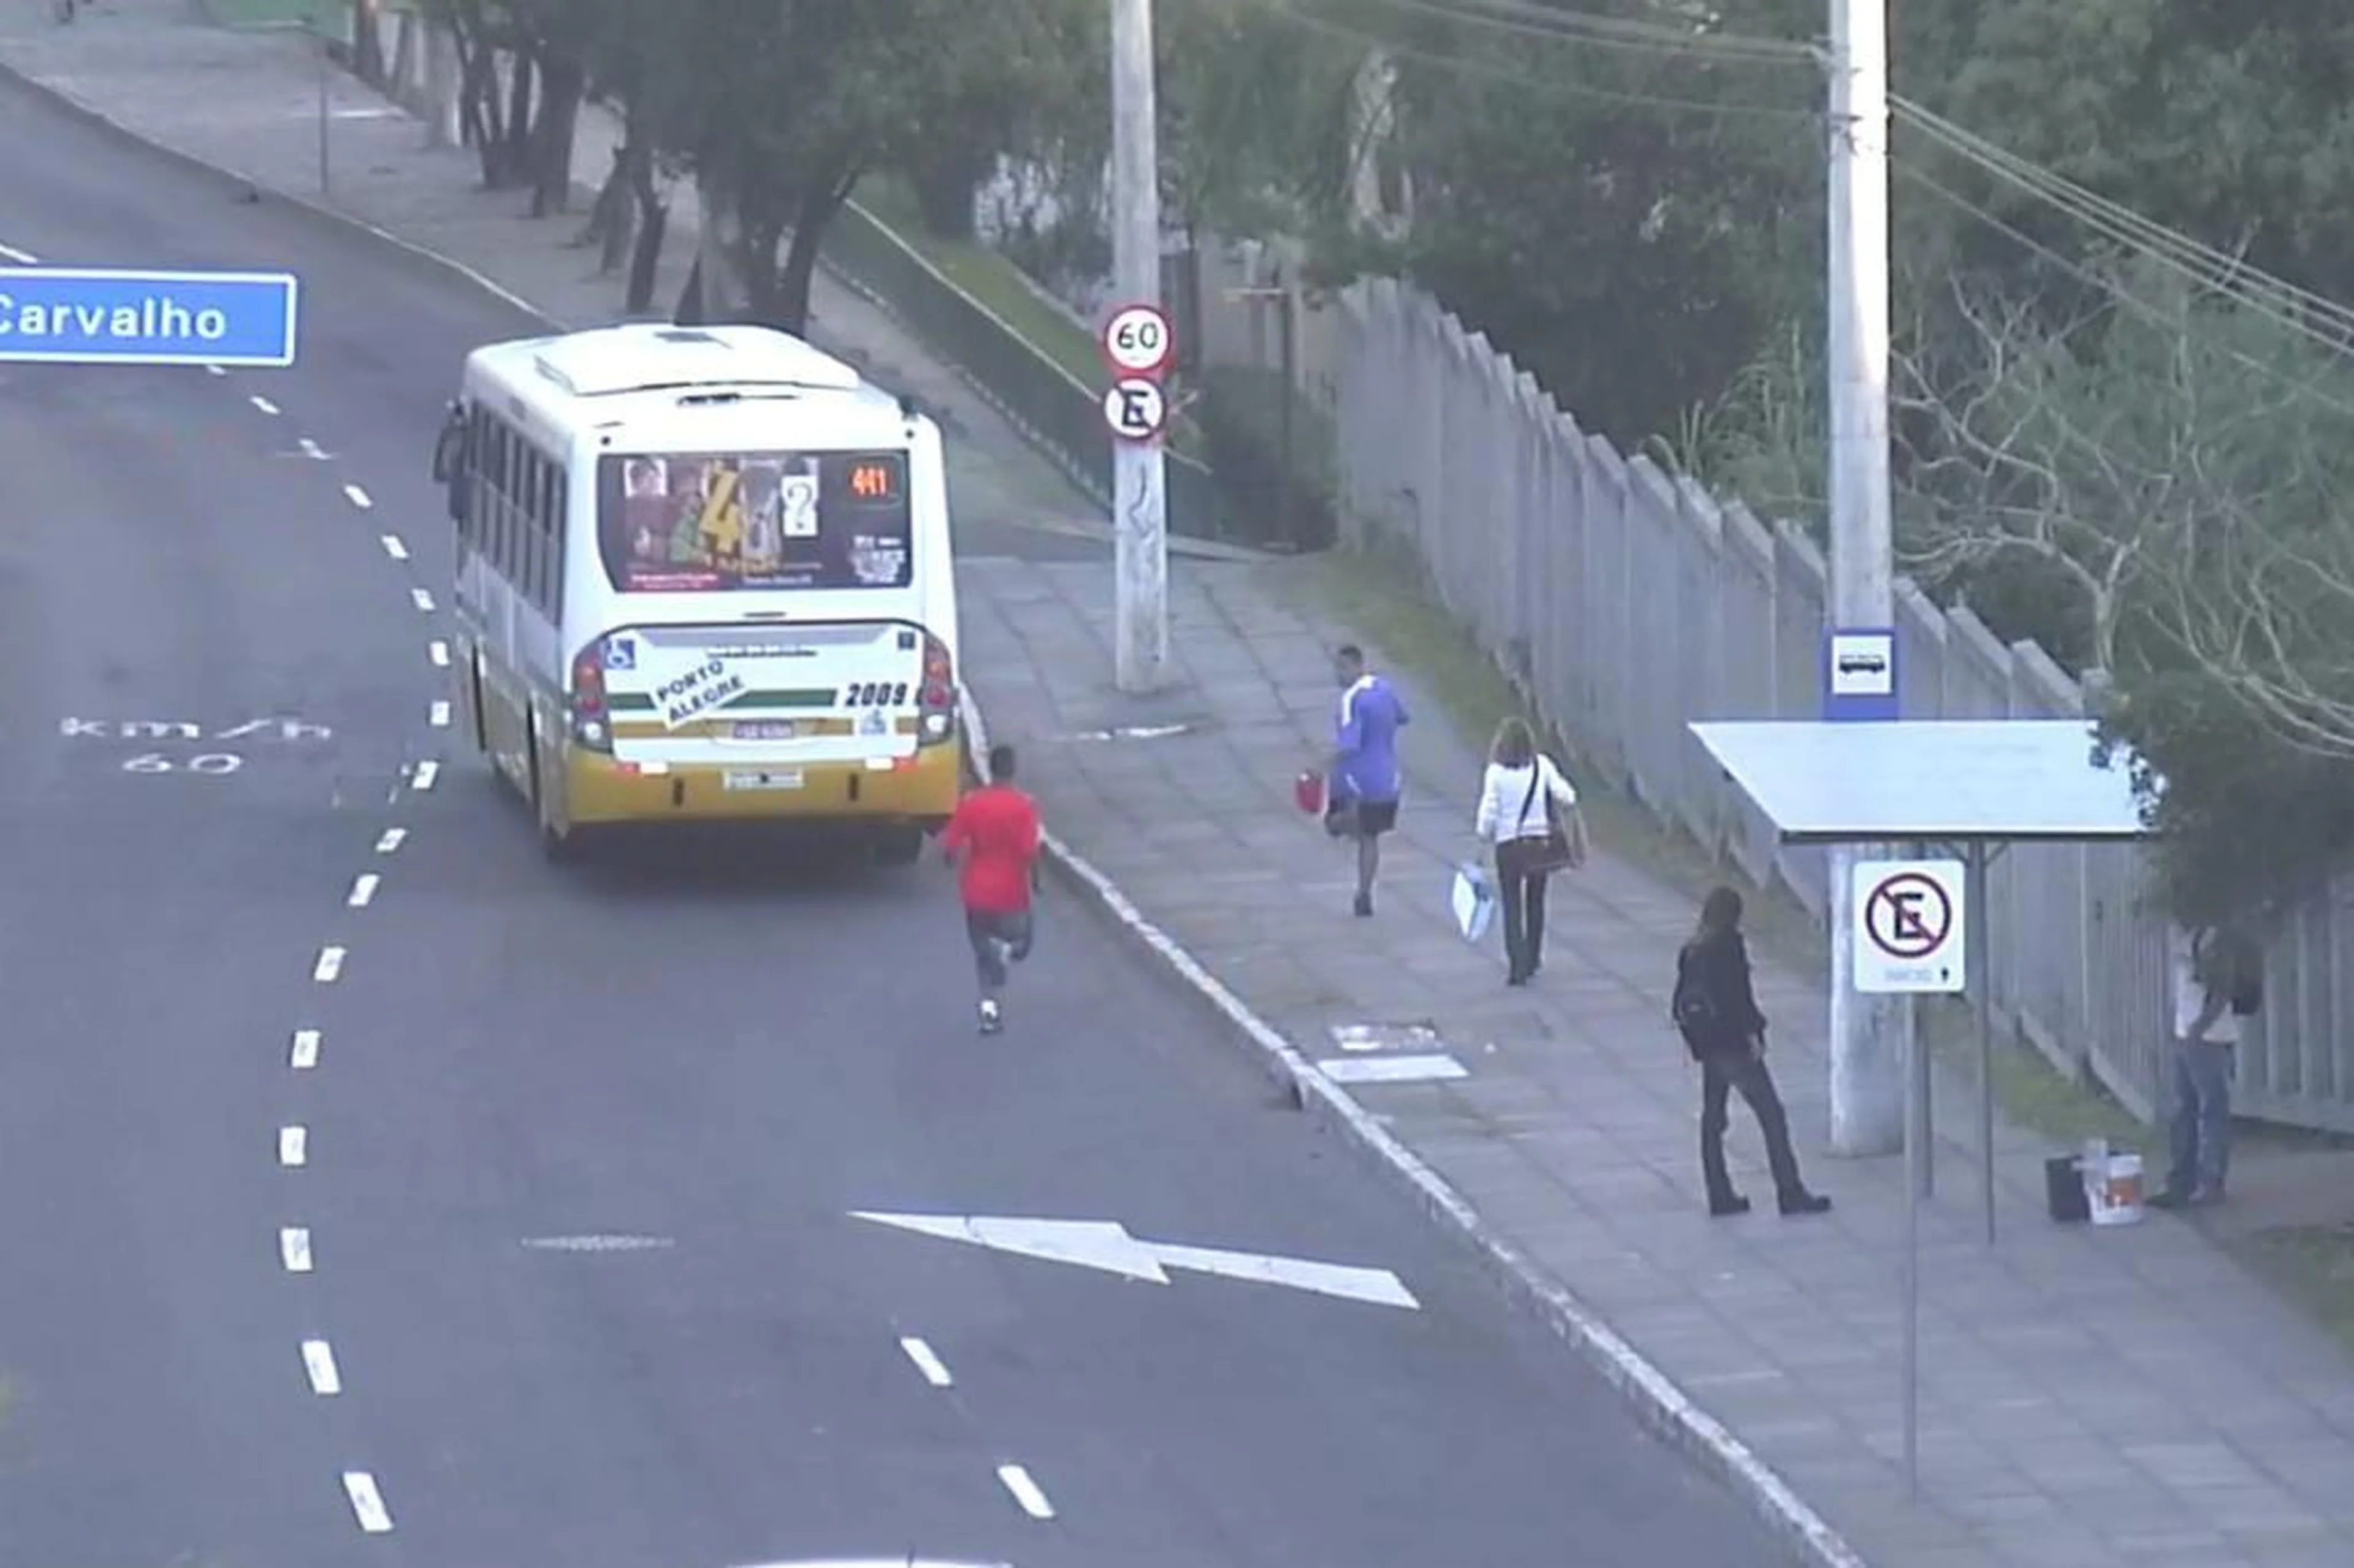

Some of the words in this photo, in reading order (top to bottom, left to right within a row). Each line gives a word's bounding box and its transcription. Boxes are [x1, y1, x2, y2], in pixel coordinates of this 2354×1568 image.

[1118, 322, 1158, 349] 60
[853, 466, 886, 496] 441
[656, 660, 723, 702] PORTO
[845, 682, 908, 707] 2009
[669, 675, 743, 722] ALEGRE
[60, 717, 332, 740] km/h
[123, 753, 243, 774] 60
